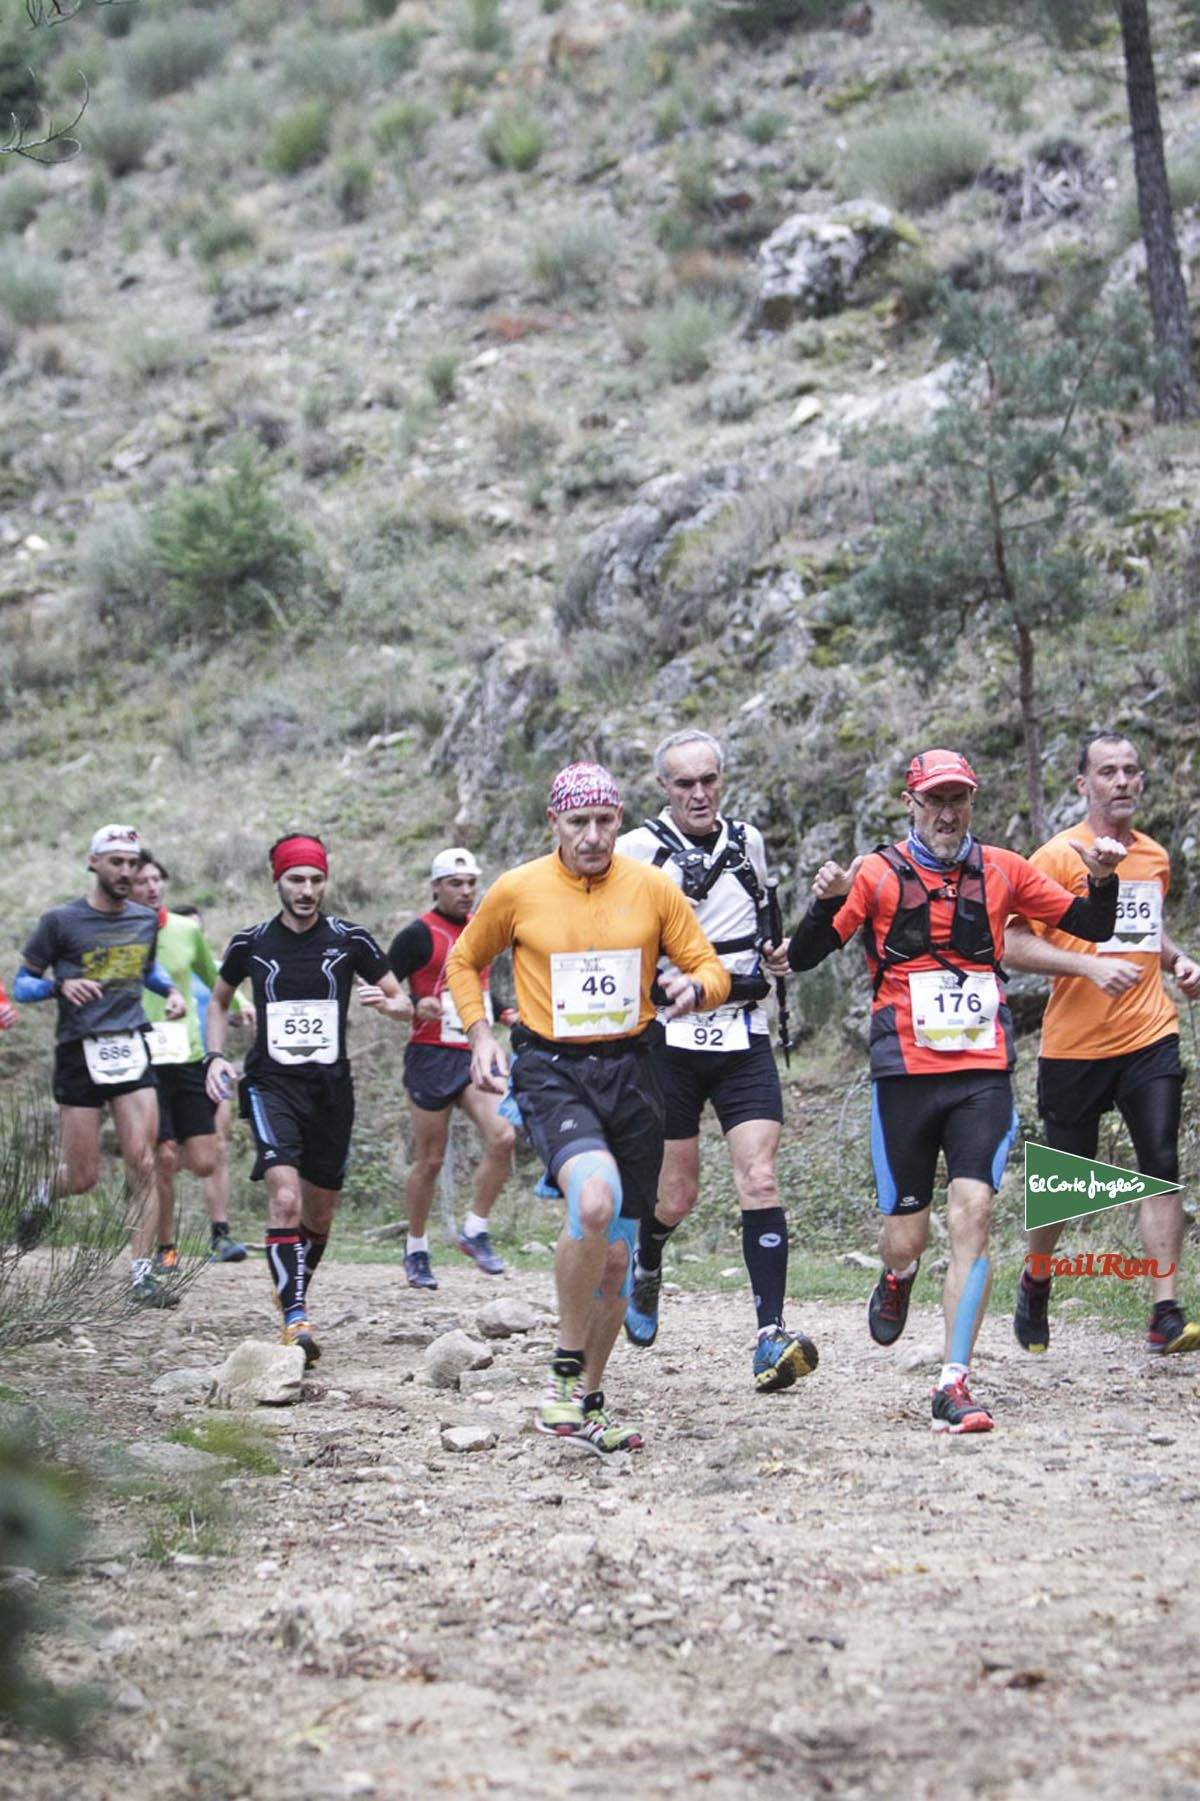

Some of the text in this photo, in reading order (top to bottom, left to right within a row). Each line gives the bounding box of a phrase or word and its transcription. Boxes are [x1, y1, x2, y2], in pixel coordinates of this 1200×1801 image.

[1115, 902, 1151, 919] 656
[581, 975, 617, 997] 46
[934, 992, 982, 1013] 176
[284, 1018, 324, 1035] 532
[694, 1027, 724, 1046] 92
